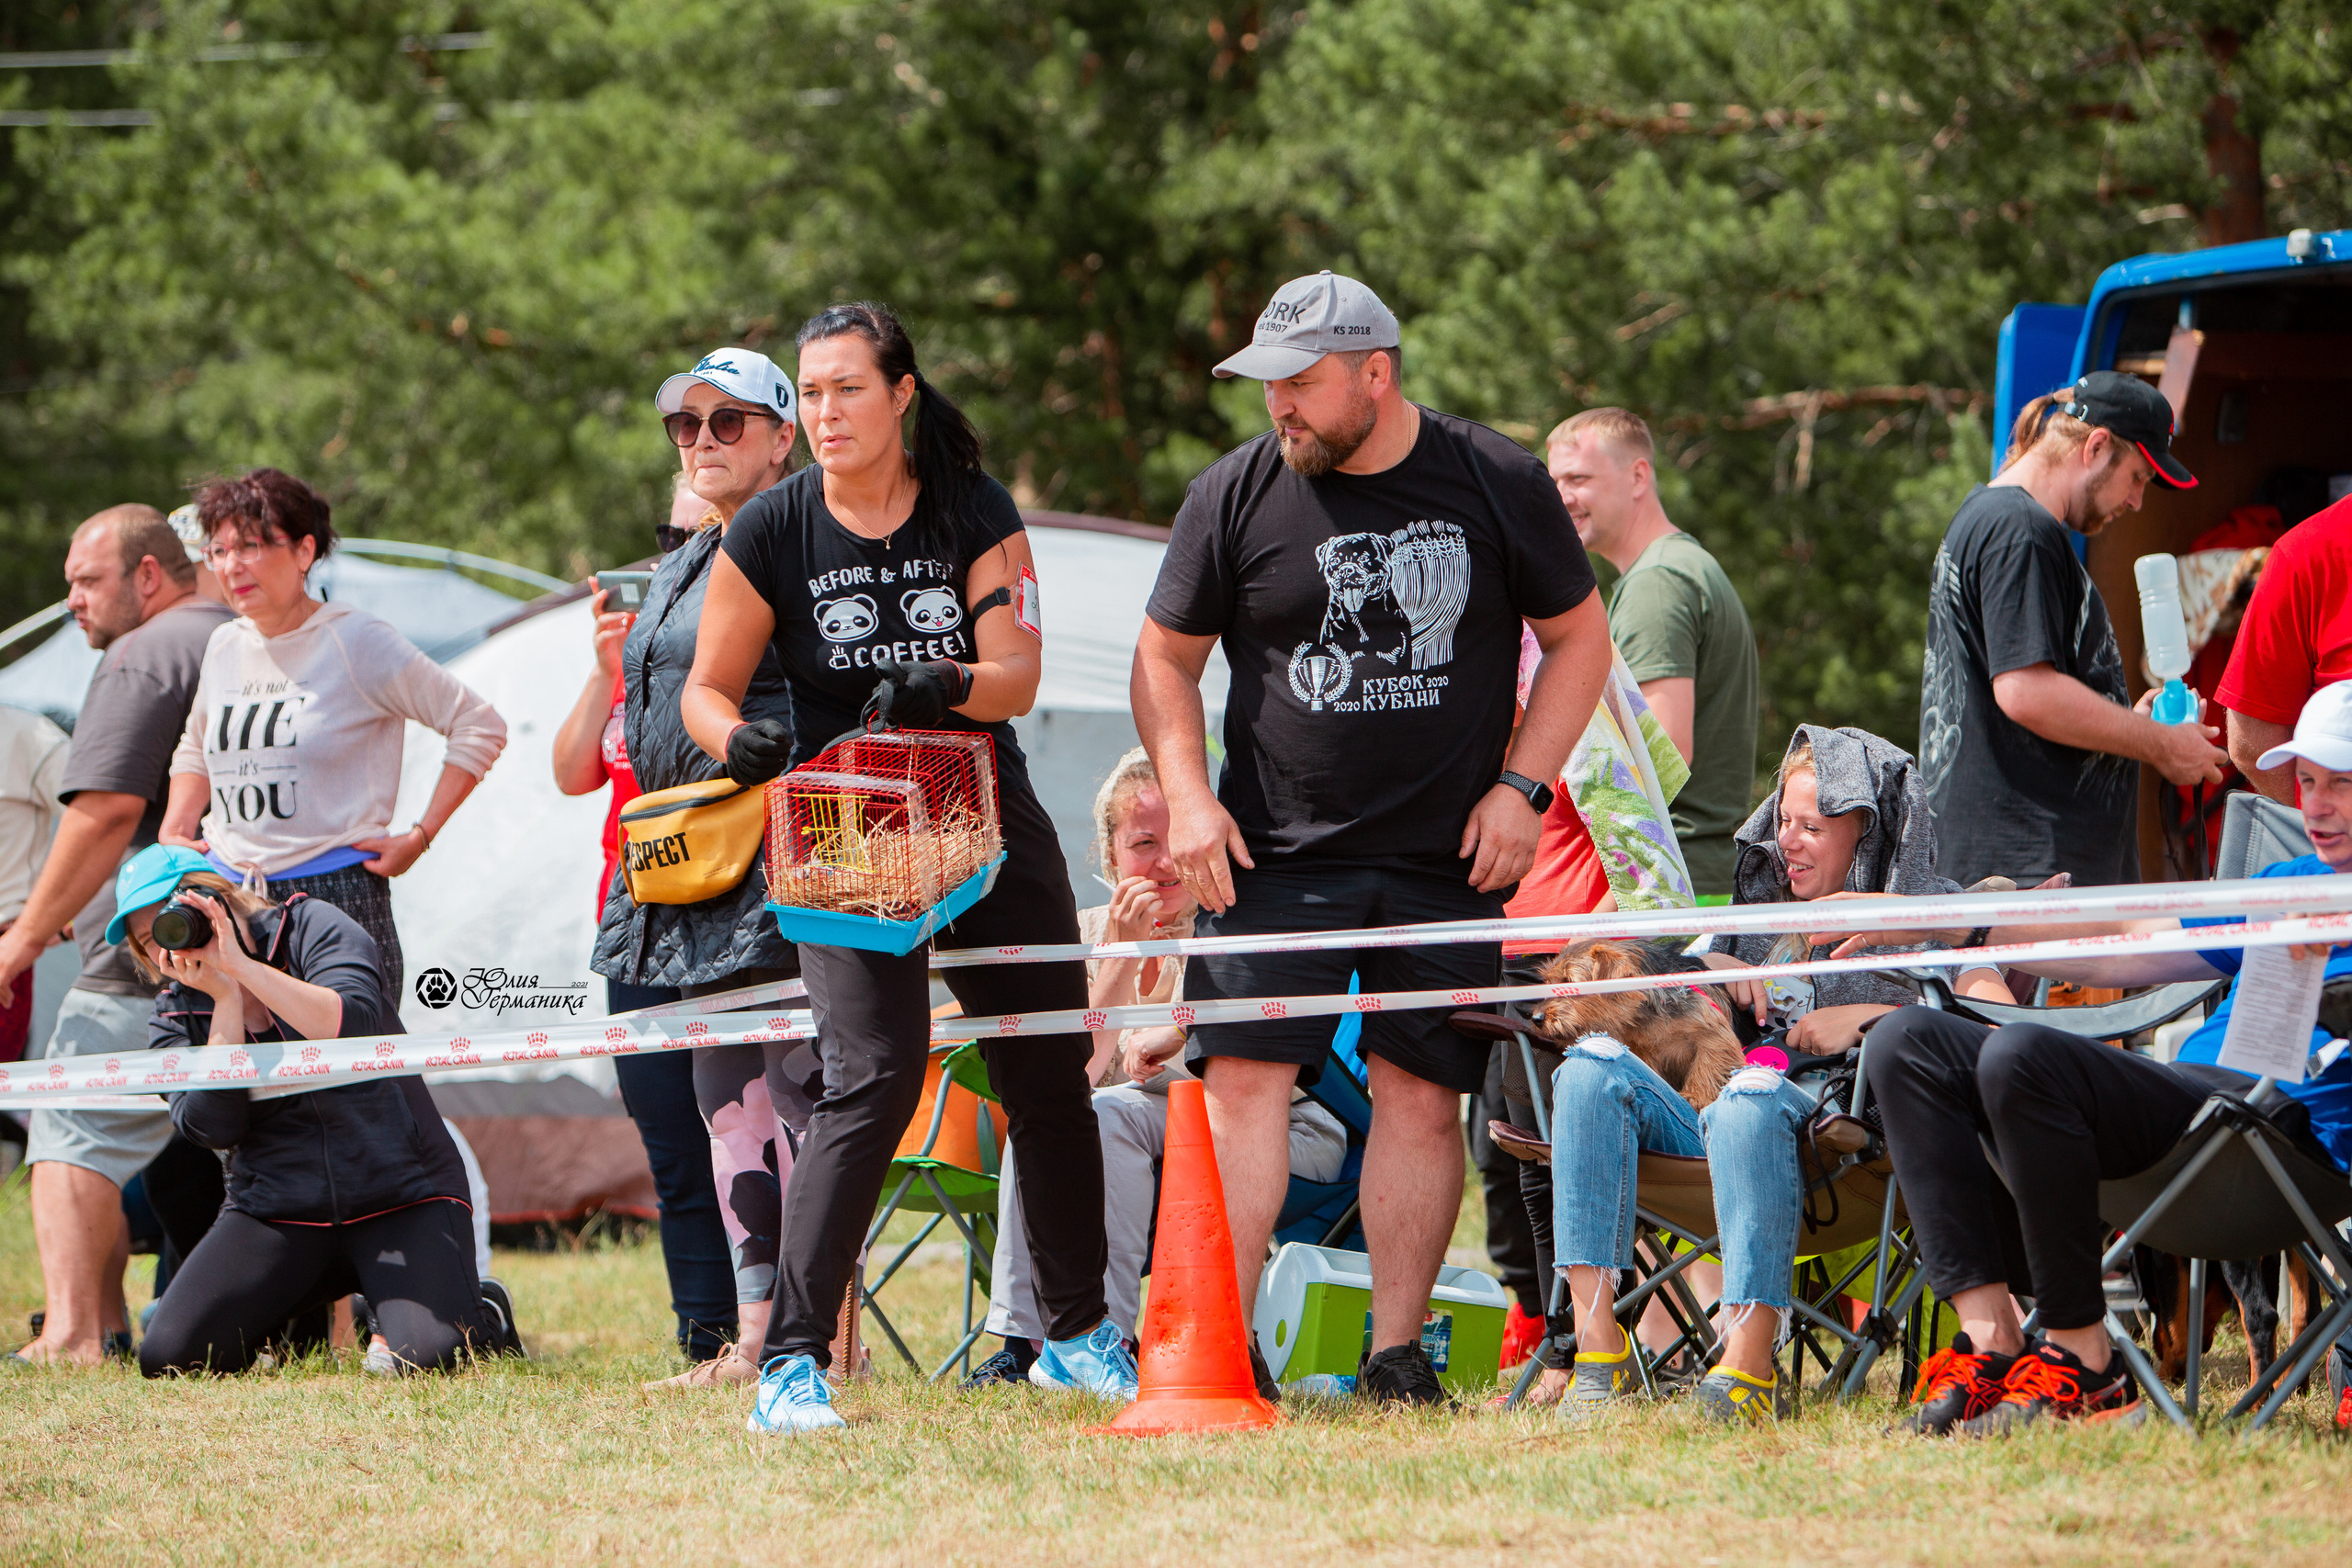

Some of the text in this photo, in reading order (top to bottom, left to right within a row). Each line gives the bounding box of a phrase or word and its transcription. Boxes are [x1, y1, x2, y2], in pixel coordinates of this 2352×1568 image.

[1266, 322, 1288, 333] 1907
[1333, 325, 1371, 335] KS 2018
[808, 566, 875, 598] BEFORE
[880, 567, 897, 584] &
[854, 630, 967, 668] COFFEE!
[241, 678, 288, 697] it's not
[1362, 673, 1449, 694] КУБОК 2020
[1333, 689, 1441, 712] 2020 КУБАНИ
[208, 695, 305, 754] ME
[238, 758, 259, 777] it's
[215, 780, 298, 824] YOU
[580, 1042, 640, 1056] ROYAL CANIN
[661, 1035, 722, 1050] ROYAL CANIN
[424, 1053, 483, 1067] ROYAL CANIN
[502, 1047, 559, 1062] ROYAL CANIN
[277, 1064, 332, 1077] ROYAL CANIN
[351, 1058, 406, 1072] ROYAL CANIN
[207, 1067, 260, 1080] ROYAL CANIN
